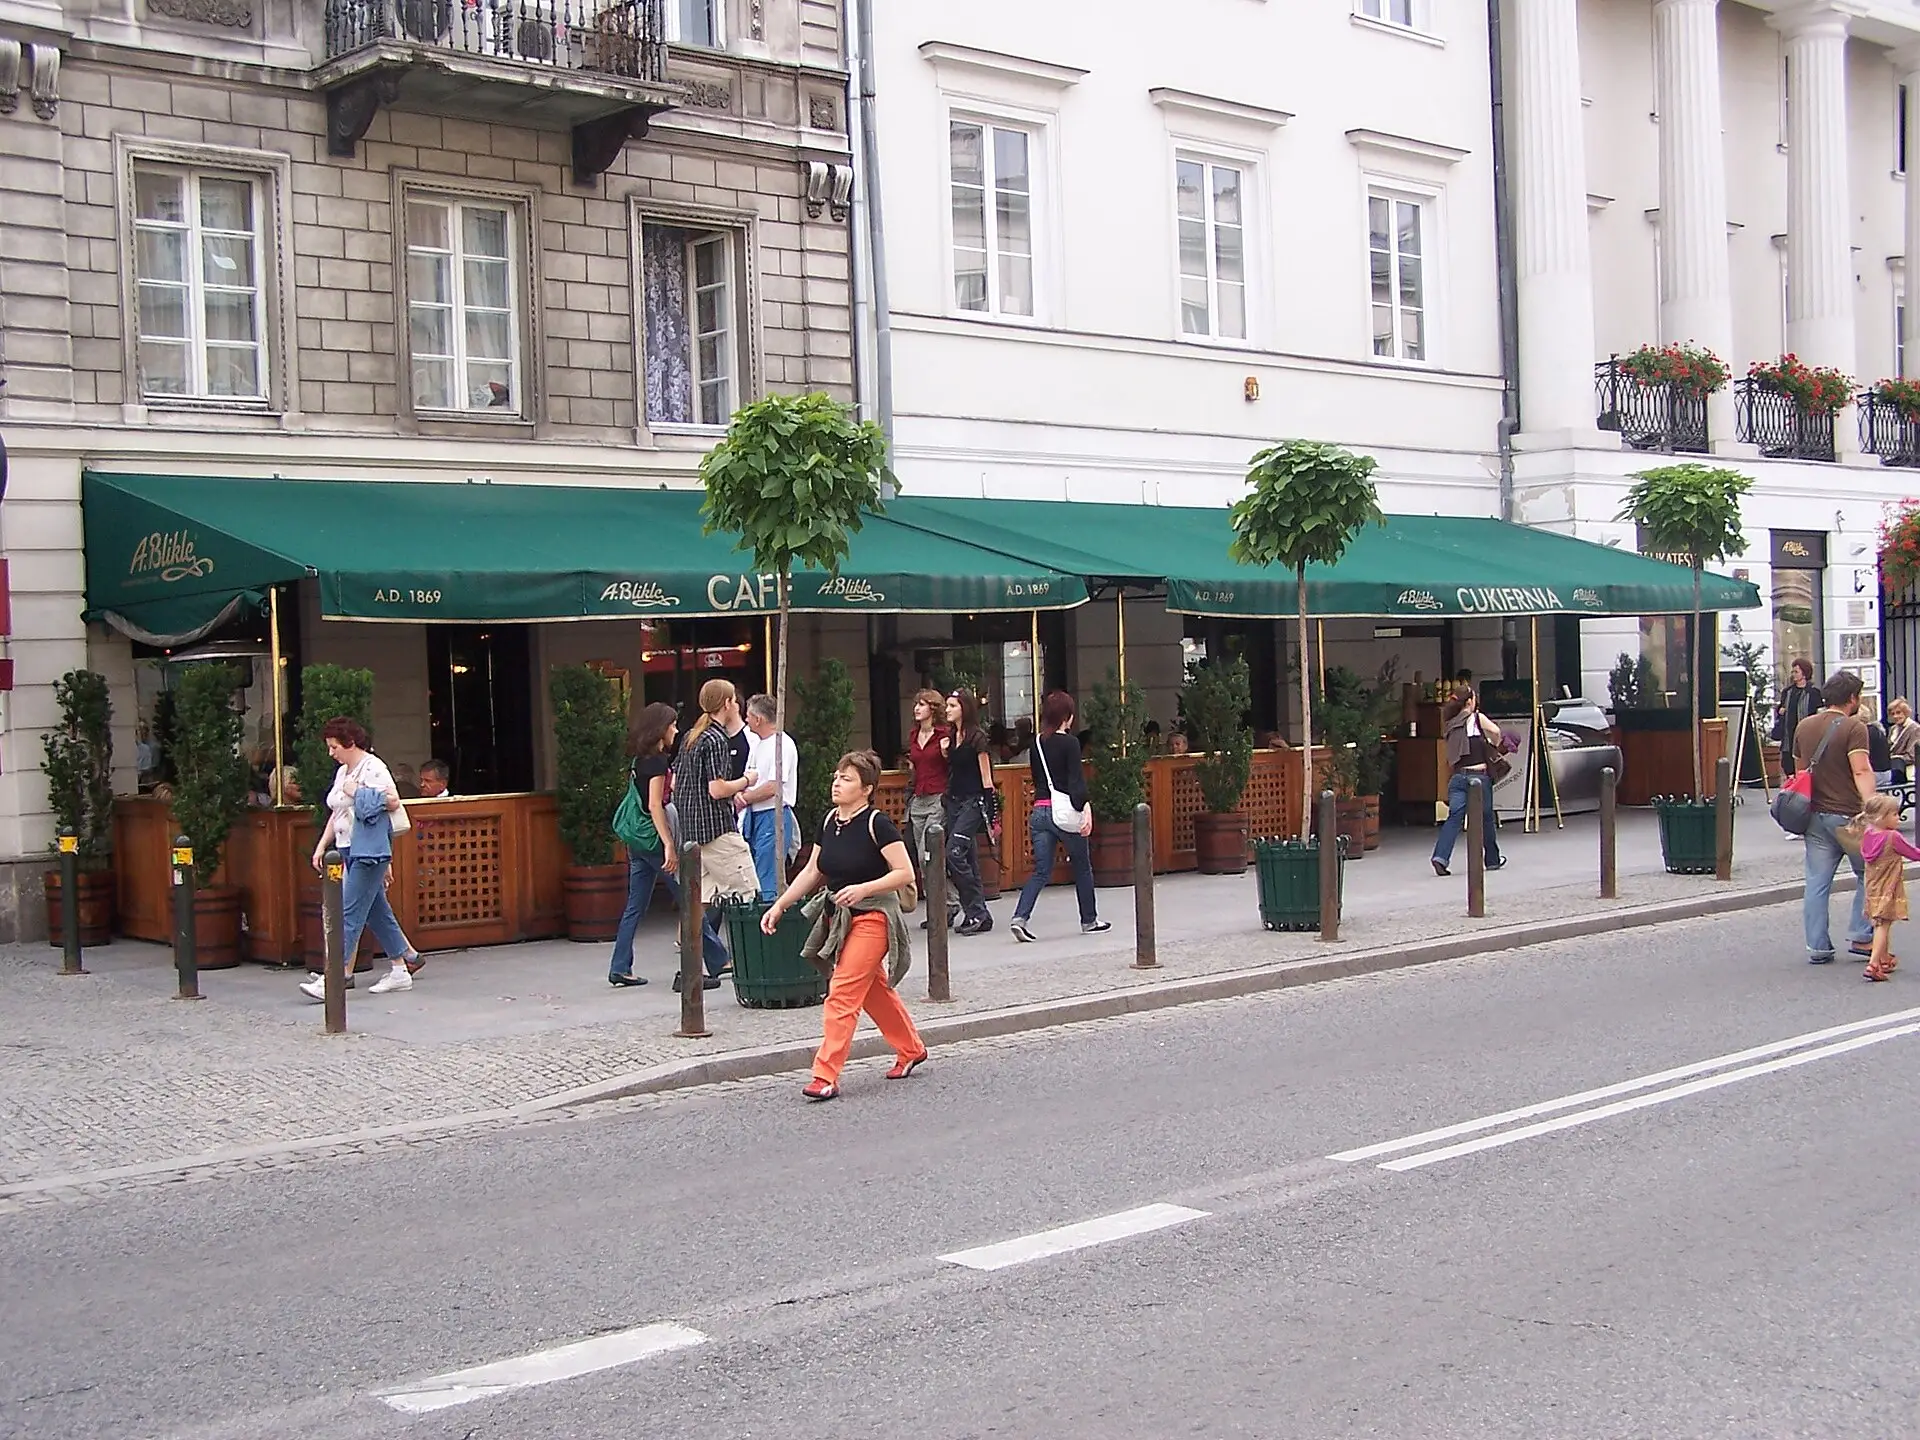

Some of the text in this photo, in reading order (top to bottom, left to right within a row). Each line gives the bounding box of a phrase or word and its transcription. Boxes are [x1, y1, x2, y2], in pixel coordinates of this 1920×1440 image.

[374, 589, 441, 603] A.D. 1869
[1027, 582, 1050, 596] 1869
[1456, 587, 1564, 612] CUKIERNIA
